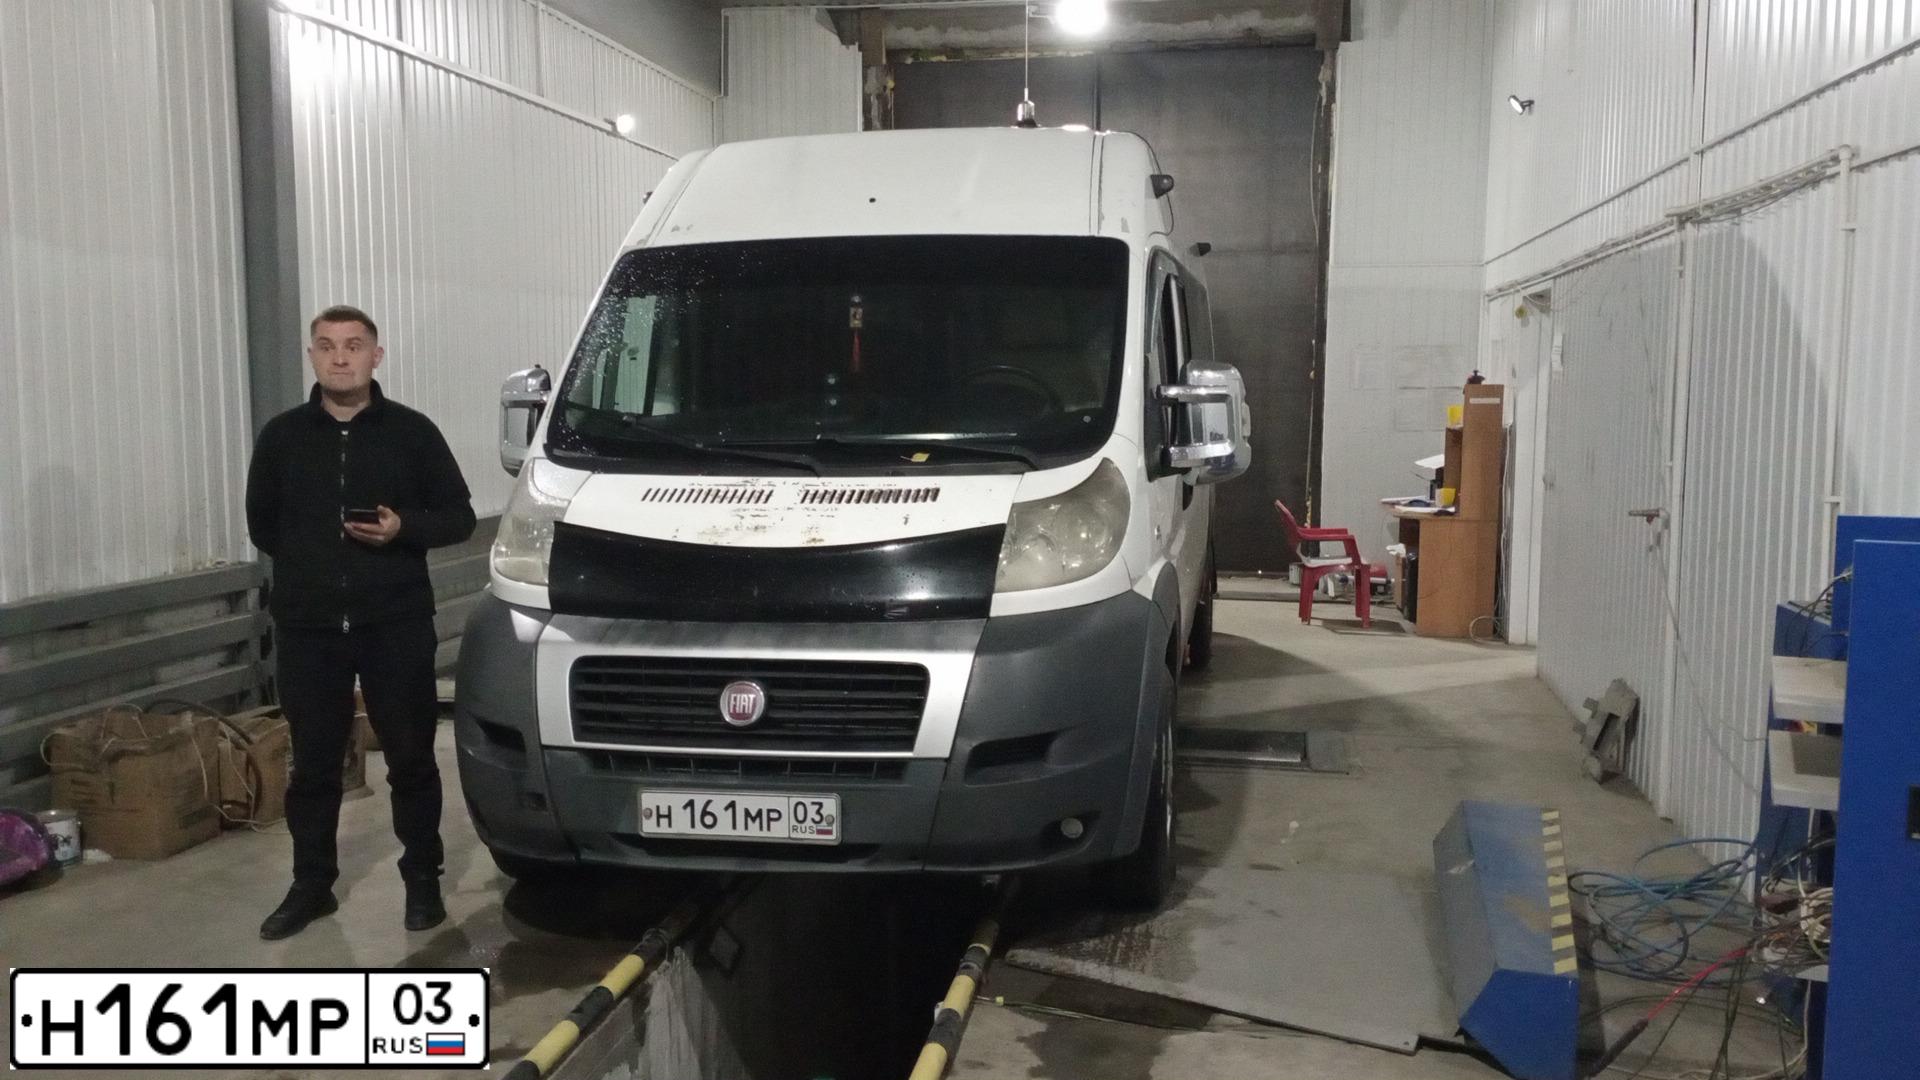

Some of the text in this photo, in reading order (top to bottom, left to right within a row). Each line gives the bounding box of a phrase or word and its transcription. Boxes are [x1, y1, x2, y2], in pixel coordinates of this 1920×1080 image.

[730, 693, 756, 714] FIAT
[793, 801, 824, 824] 03
[792, 825, 815, 834] RUS
